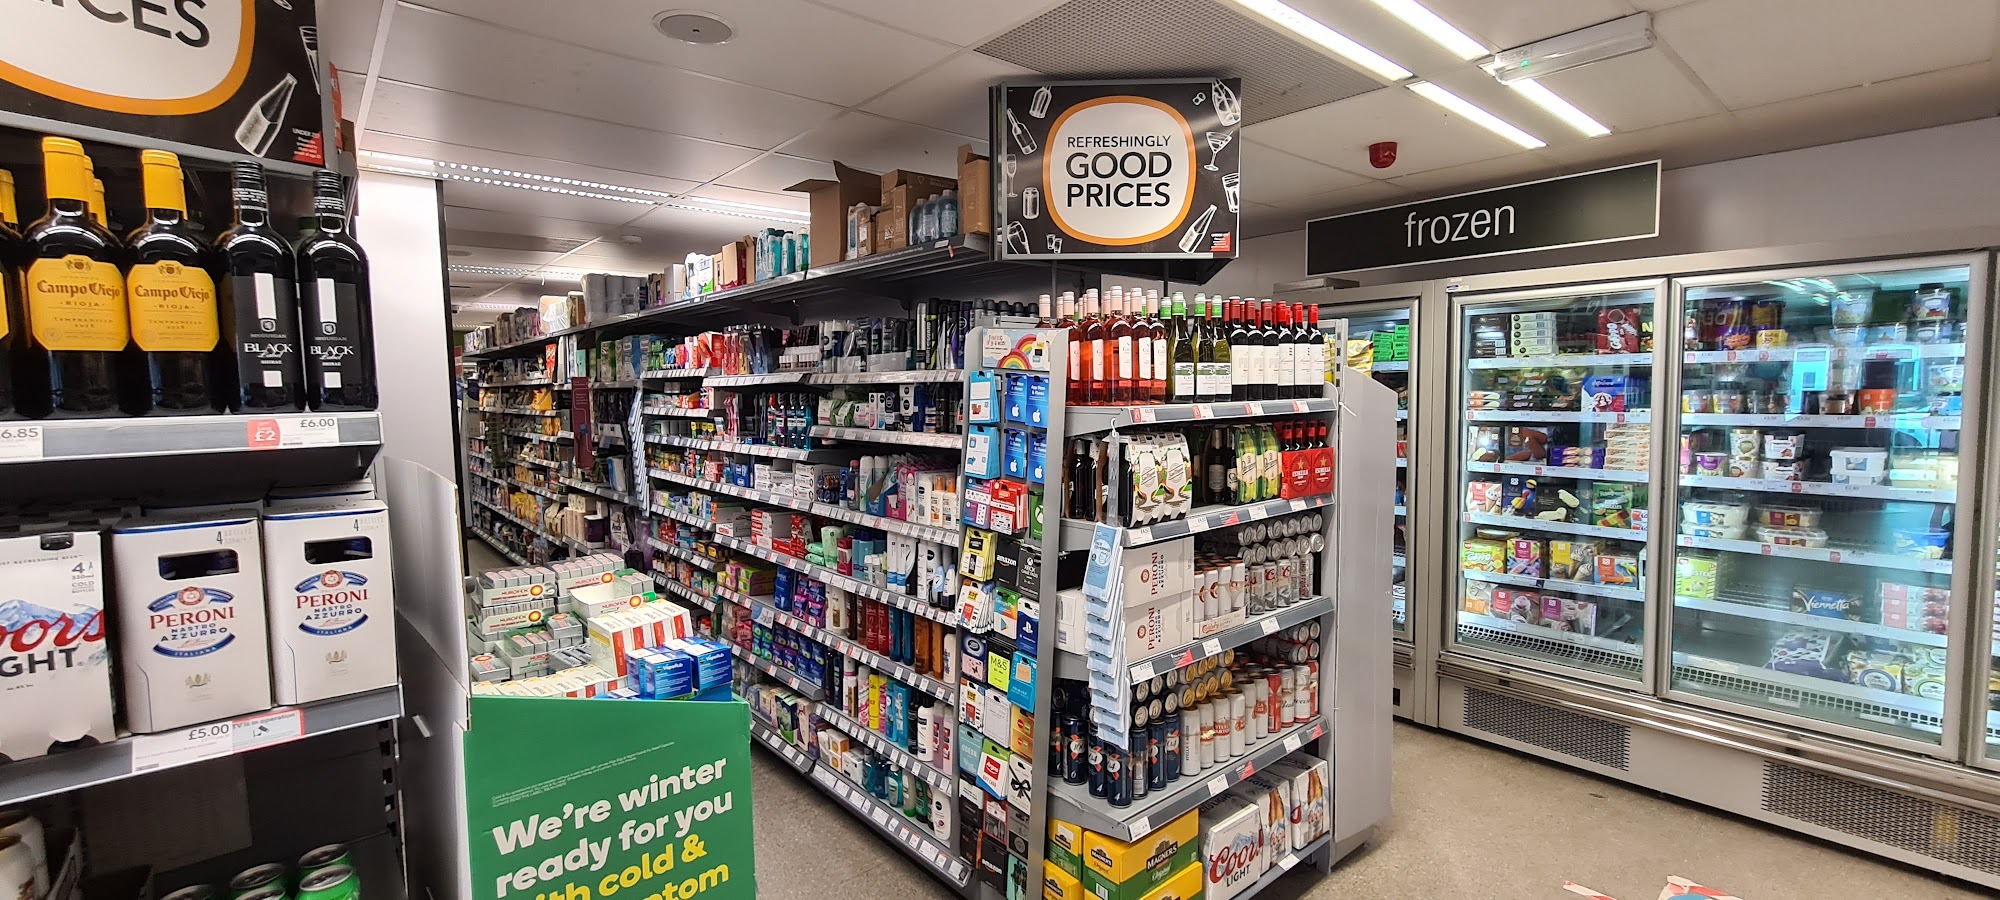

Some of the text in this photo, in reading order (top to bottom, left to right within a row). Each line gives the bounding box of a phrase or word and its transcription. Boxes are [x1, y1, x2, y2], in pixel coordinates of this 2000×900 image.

[1067, 135, 1172, 148] REFRESHINGLY
[1065, 152, 1172, 179] GOOD
[1067, 182, 1171, 208] PRICES
[1405, 204, 1515, 247] frozen
[37, 280, 121, 300] Campo Viejo
[134, 284, 210, 303] Campo Viejo
[244, 342, 293, 353] BLACK
[310, 345, 354, 355] BLACK
[300, 418, 335, 428] £6.00
[254, 430, 276, 442] £2
[1292, 469, 1309, 477] ESTRELLA
[1315, 466, 1331, 474] ESTRELLA
[353, 518, 359, 532] 4
[216, 531, 223, 545] 4
[996, 554, 1017, 567] amazon
[72, 562, 85, 574] 4
[1150, 551, 1158, 596] PERONI
[575, 576, 600, 586] NUROFEN
[297, 589, 368, 609] PERONI
[501, 588, 529, 596] NUROFEN
[314, 604, 352, 613] NASTRO
[602, 600, 628, 609] NUROFEN
[1800, 595, 1850, 611] Viennetta
[150, 606, 236, 630] PERONI
[305, 608, 362, 620] AZZURRO
[500, 614, 527, 623] NUROFEN
[160, 627, 228, 641] AZZURRO
[171, 622, 216, 633] NASTRO
[1147, 606, 1155, 651] PERONI
[706, 652, 725, 661] VapoRub
[990, 655, 1007, 671] M&S
[663, 662, 684, 671] VapoRub
[260, 713, 296, 724] operation
[188, 723, 230, 741] £5.00
[985, 761, 999, 774] Argos
[618, 757, 728, 813] winter
[496, 836, 612, 898] ready
[619, 814, 669, 851] for
[674, 791, 733, 838] you
[1091, 850, 1112, 867] MAGNERS
[1147, 844, 1178, 870] MAGNERS
[598, 843, 675, 897] cold
[681, 834, 708, 862] &
[1151, 863, 1172, 881] Original
[1226, 864, 1250, 888] LIGHT
